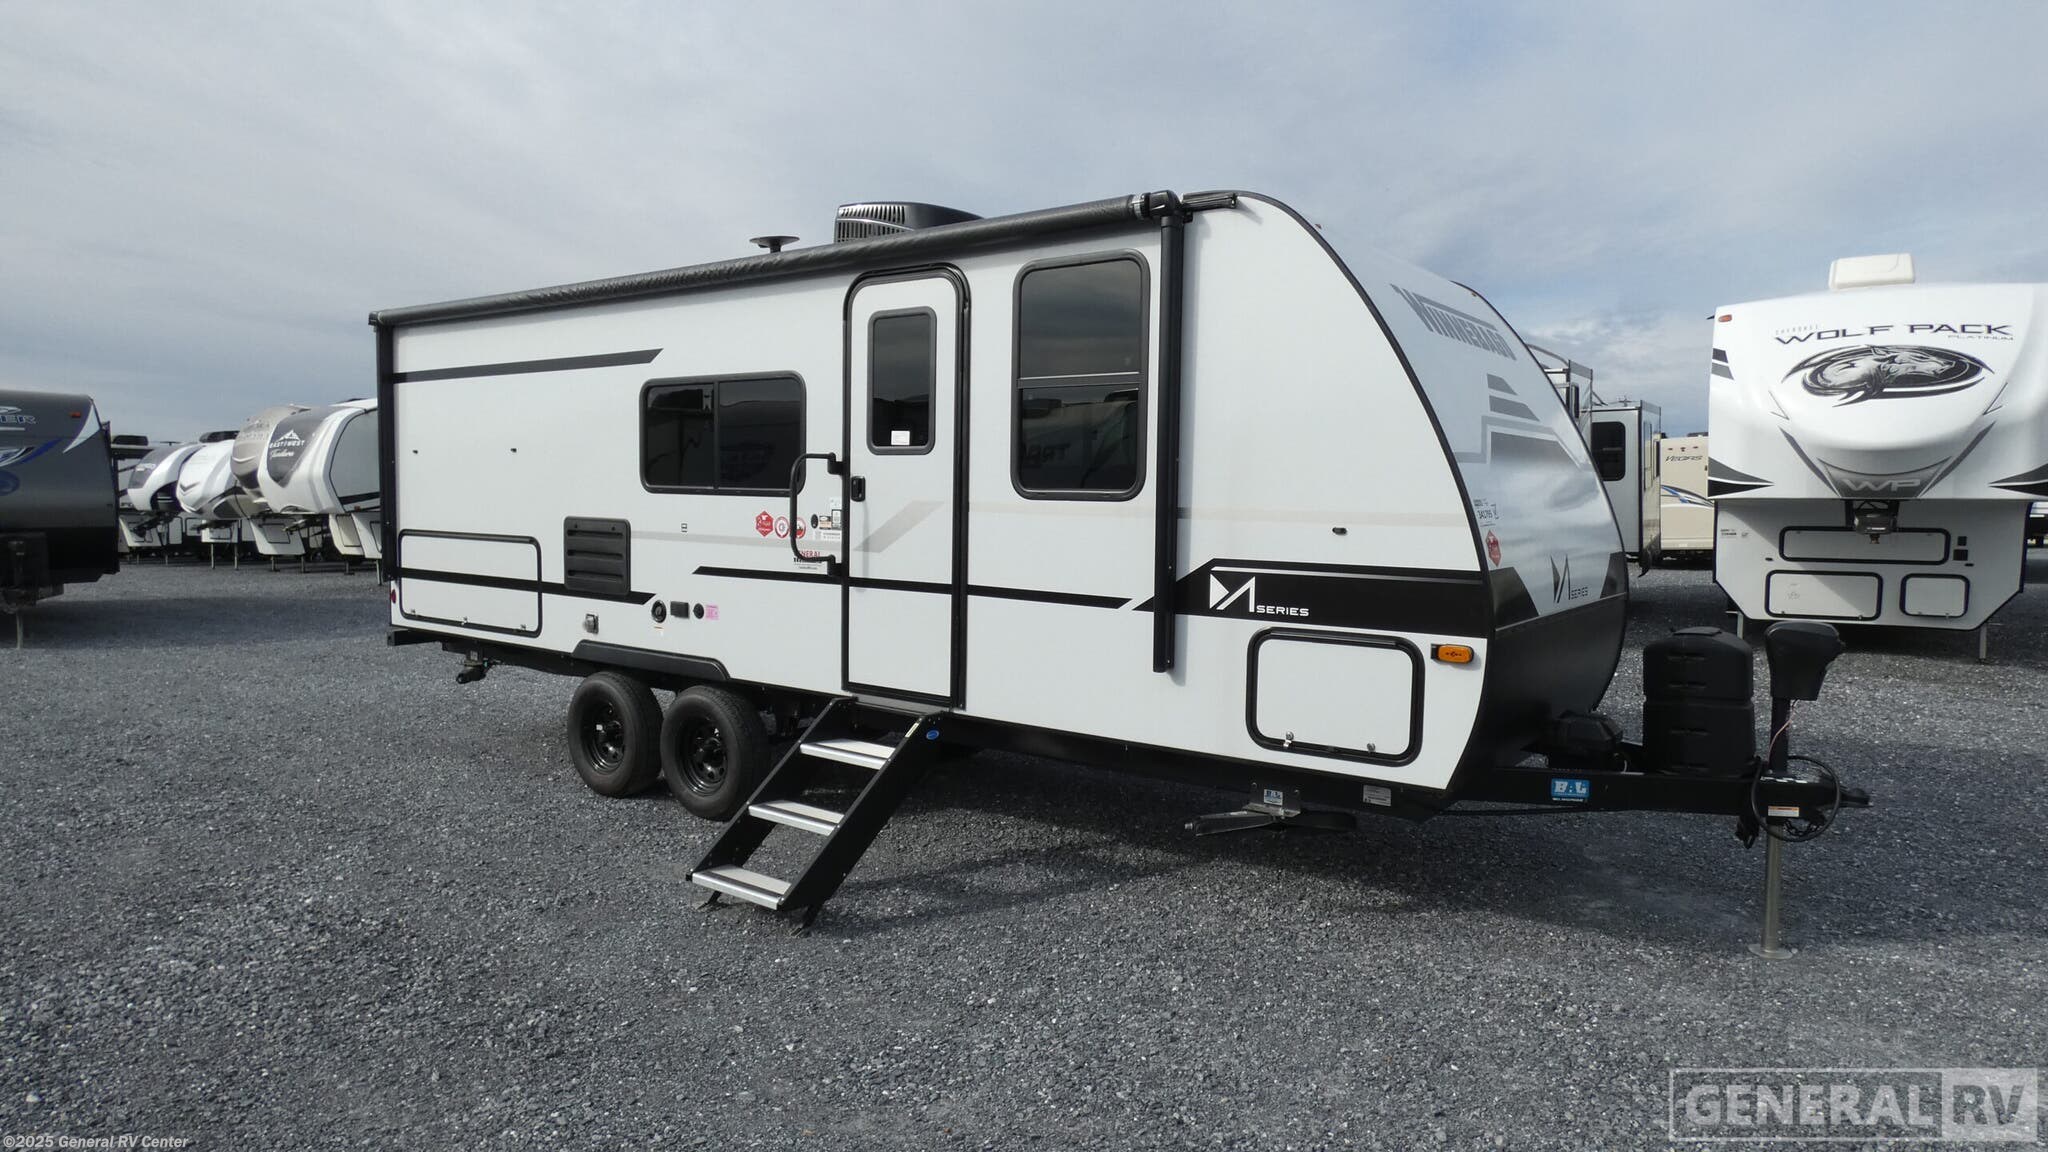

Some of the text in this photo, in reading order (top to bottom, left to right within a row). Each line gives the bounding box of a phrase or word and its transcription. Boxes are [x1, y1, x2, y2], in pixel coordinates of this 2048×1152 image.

[1775, 324, 2014, 345] WOLF PACK
[1841, 479, 1921, 492] WP
[1571, 586, 1588, 600] SERIES
[1256, 605, 1310, 617] SERIES
